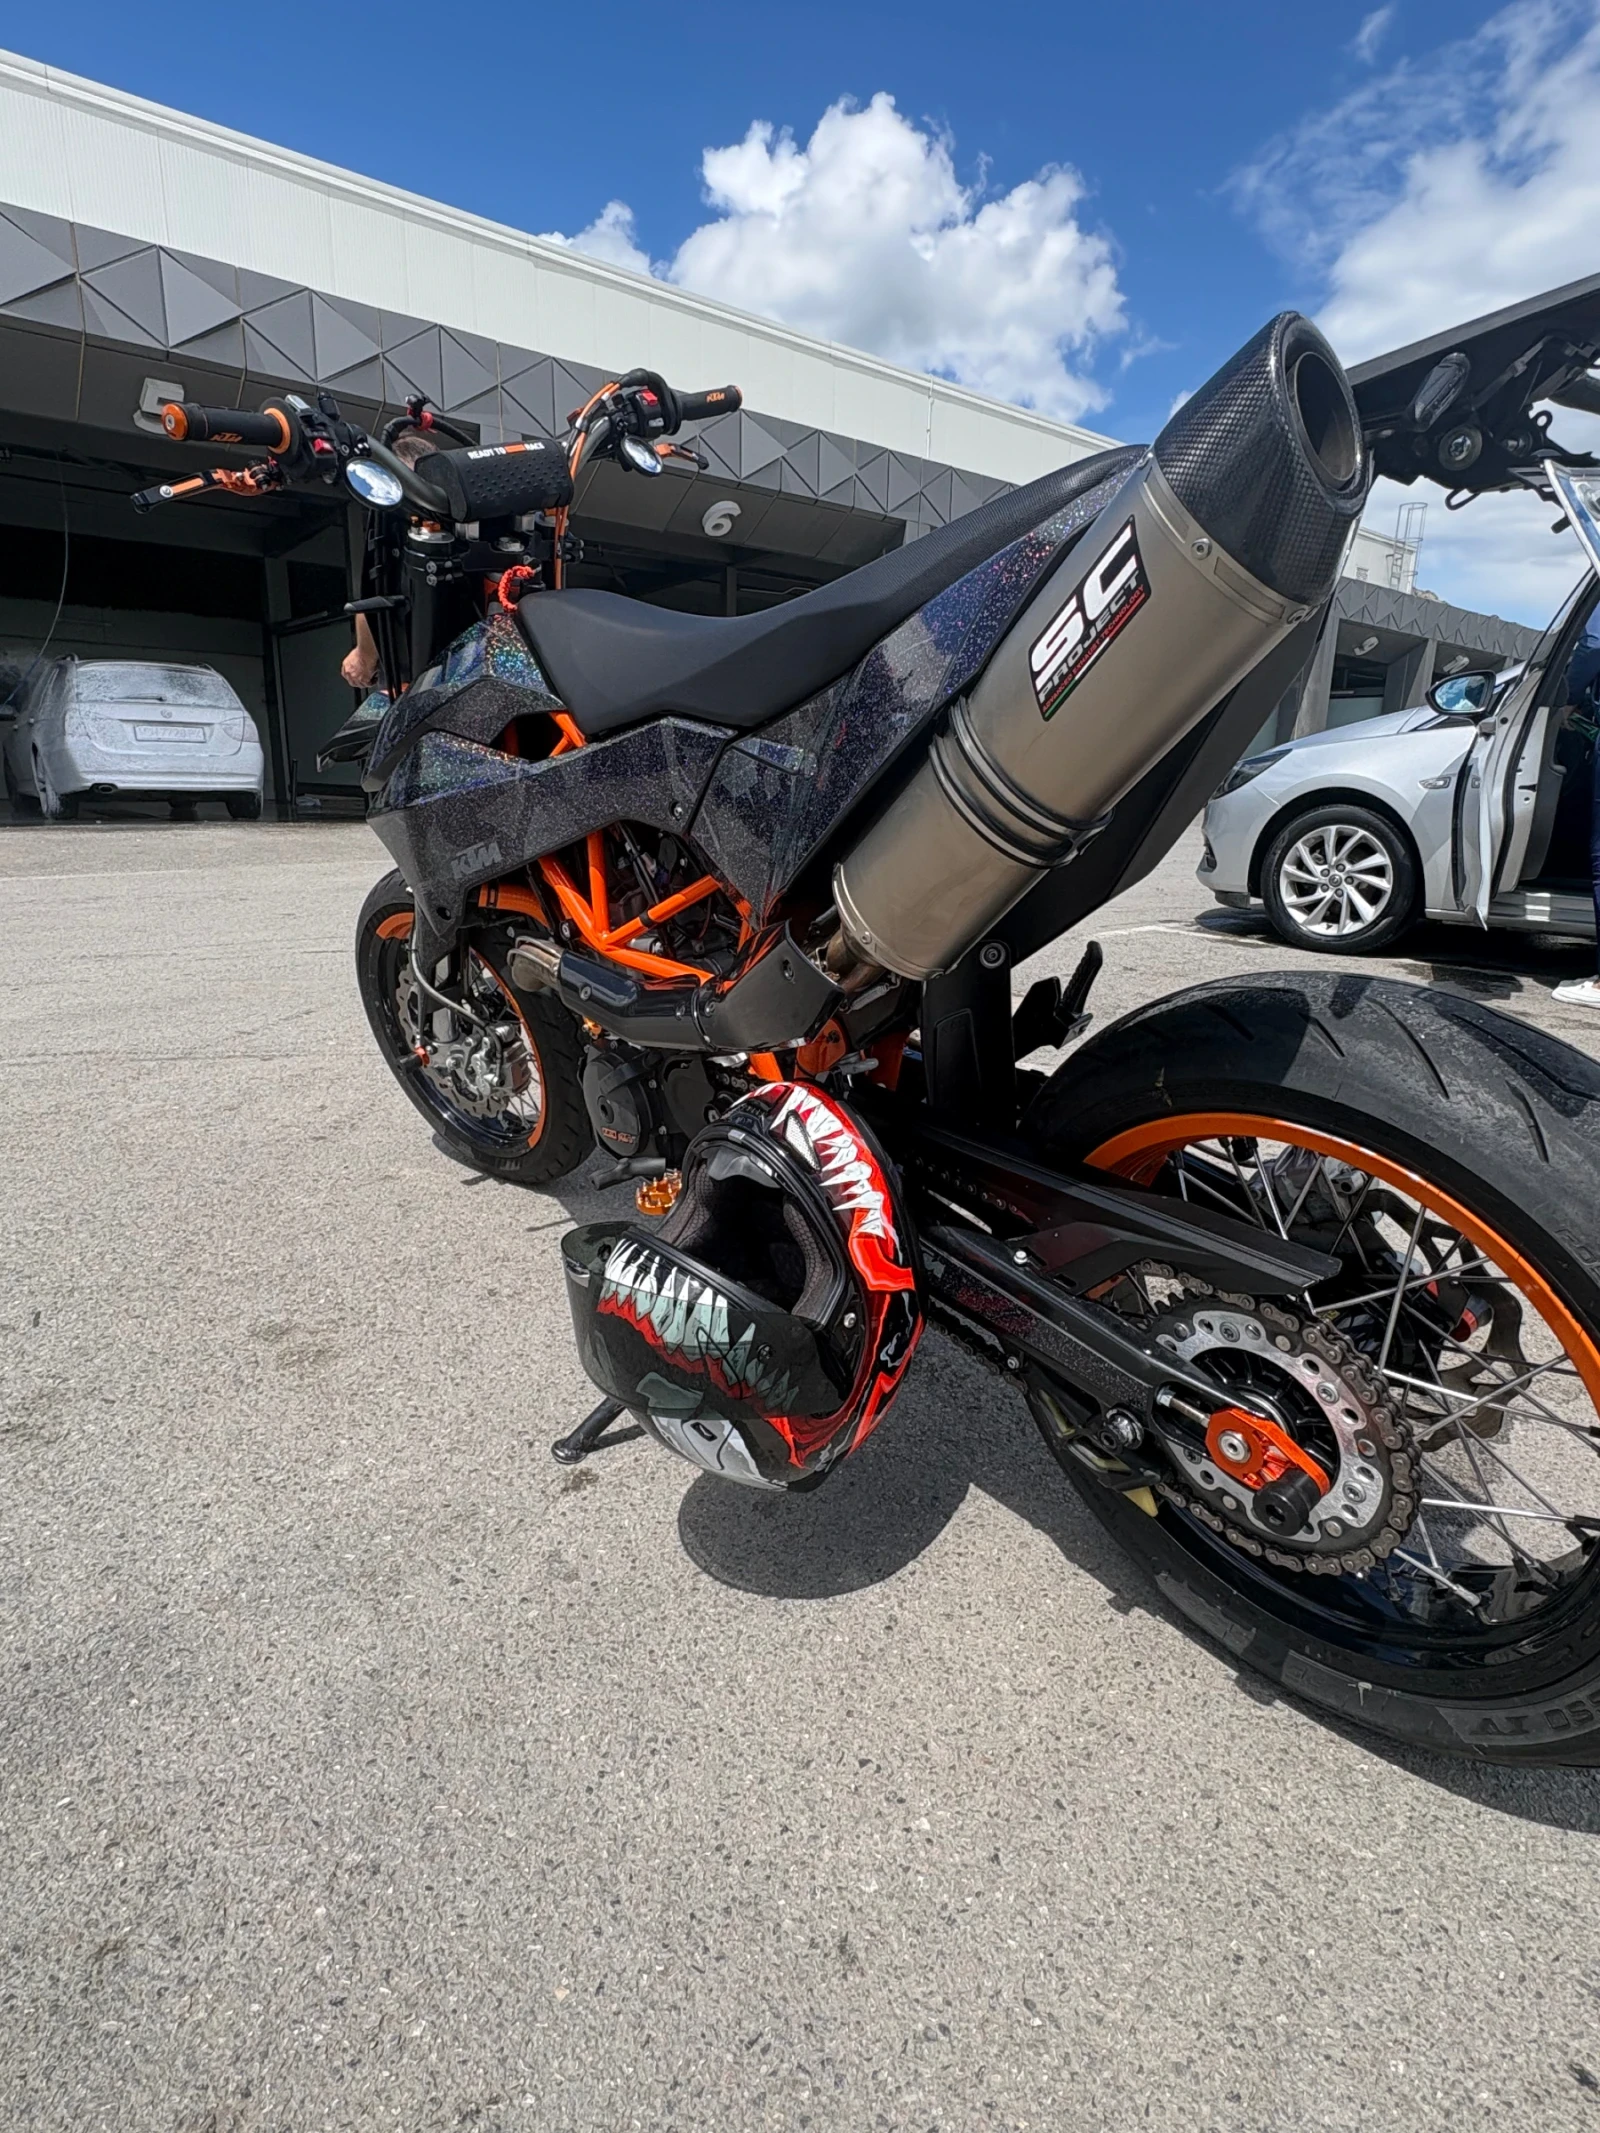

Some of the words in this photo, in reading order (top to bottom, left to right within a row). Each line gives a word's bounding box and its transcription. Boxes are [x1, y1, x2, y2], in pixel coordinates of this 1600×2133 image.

[706, 391, 726, 403] KTM
[209, 432, 243, 443] KTM
[467, 447, 494, 459] READY
[494, 446, 507, 456] TO
[524, 441, 545, 451] RACE
[702, 500, 742, 537] 6
[1038, 570, 1140, 704] PROJECT
[1042, 672, 1073, 712] ADVANCED
[1071, 638, 1102, 676] EXHAUST
[1100, 584, 1145, 641] TECHNOLOGY
[1353, 636, 1379, 656] 9
[450, 842, 504, 880] KTM
